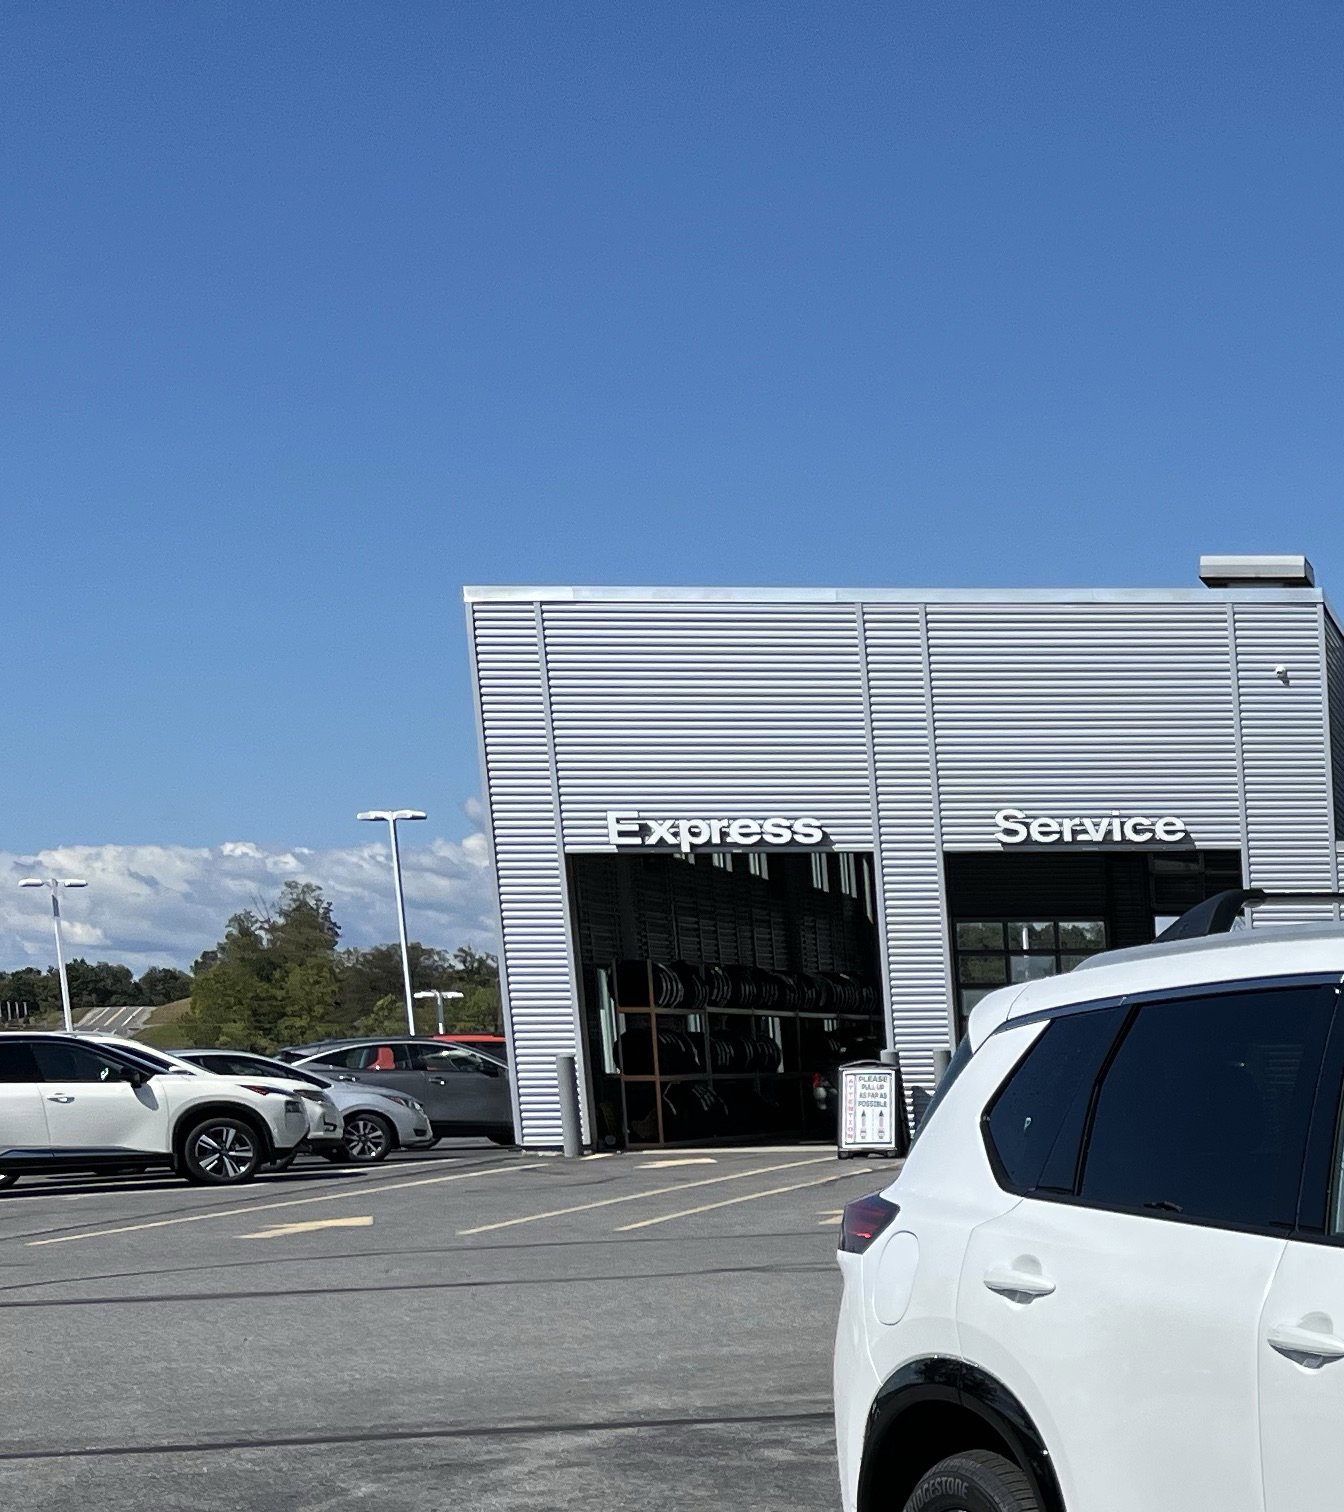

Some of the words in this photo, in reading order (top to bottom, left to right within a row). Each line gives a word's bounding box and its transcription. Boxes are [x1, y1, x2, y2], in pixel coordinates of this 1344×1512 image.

[606, 811, 823, 852] Express
[994, 809, 1186, 844] Service
[858, 1100, 888, 1108] POSSIBLE
